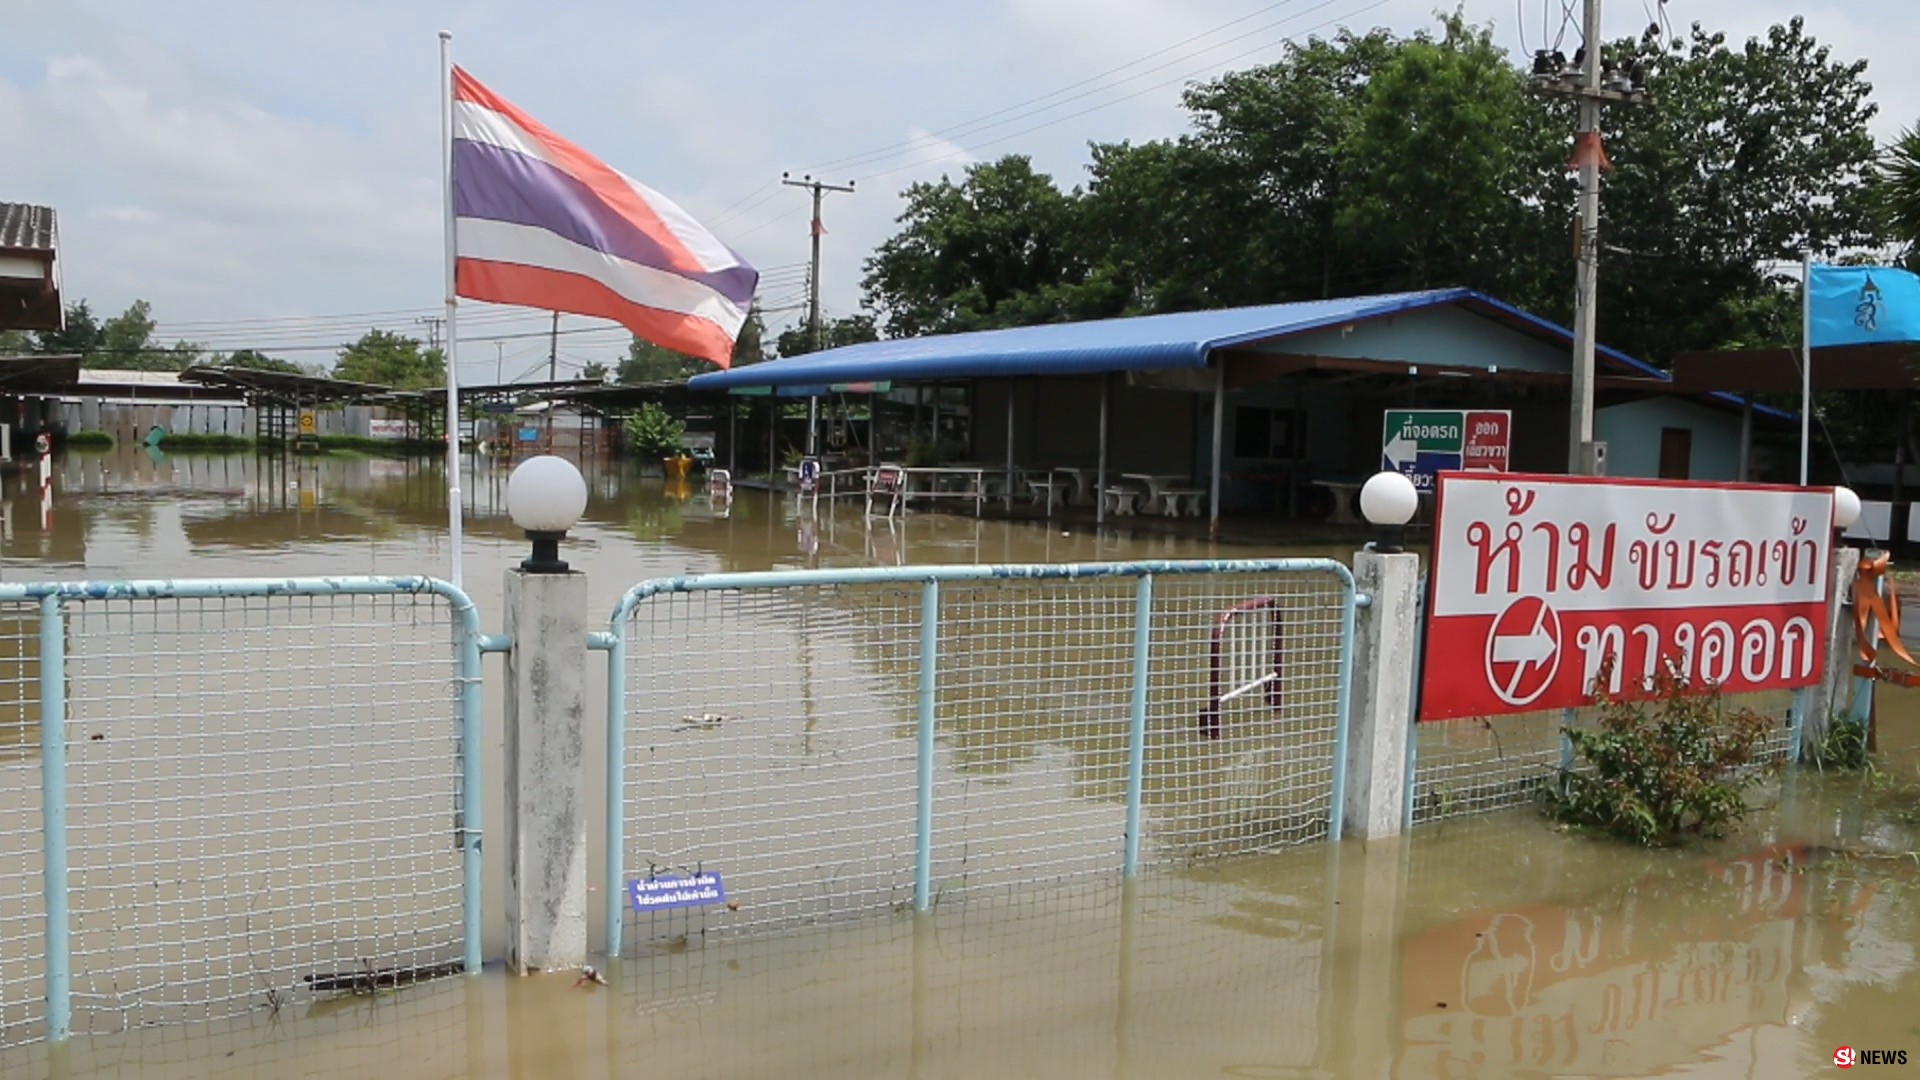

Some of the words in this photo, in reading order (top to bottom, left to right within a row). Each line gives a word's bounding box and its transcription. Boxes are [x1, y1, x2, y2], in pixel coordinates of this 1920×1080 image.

[1402, 414, 1459, 440] ที่จอดรถ
[1475, 421, 1499, 436] ออก
[1466, 486, 1617, 595] ห้าม
[1628, 511, 1818, 591] ขับรถเข้า
[1576, 616, 1815, 697] ทางออก
